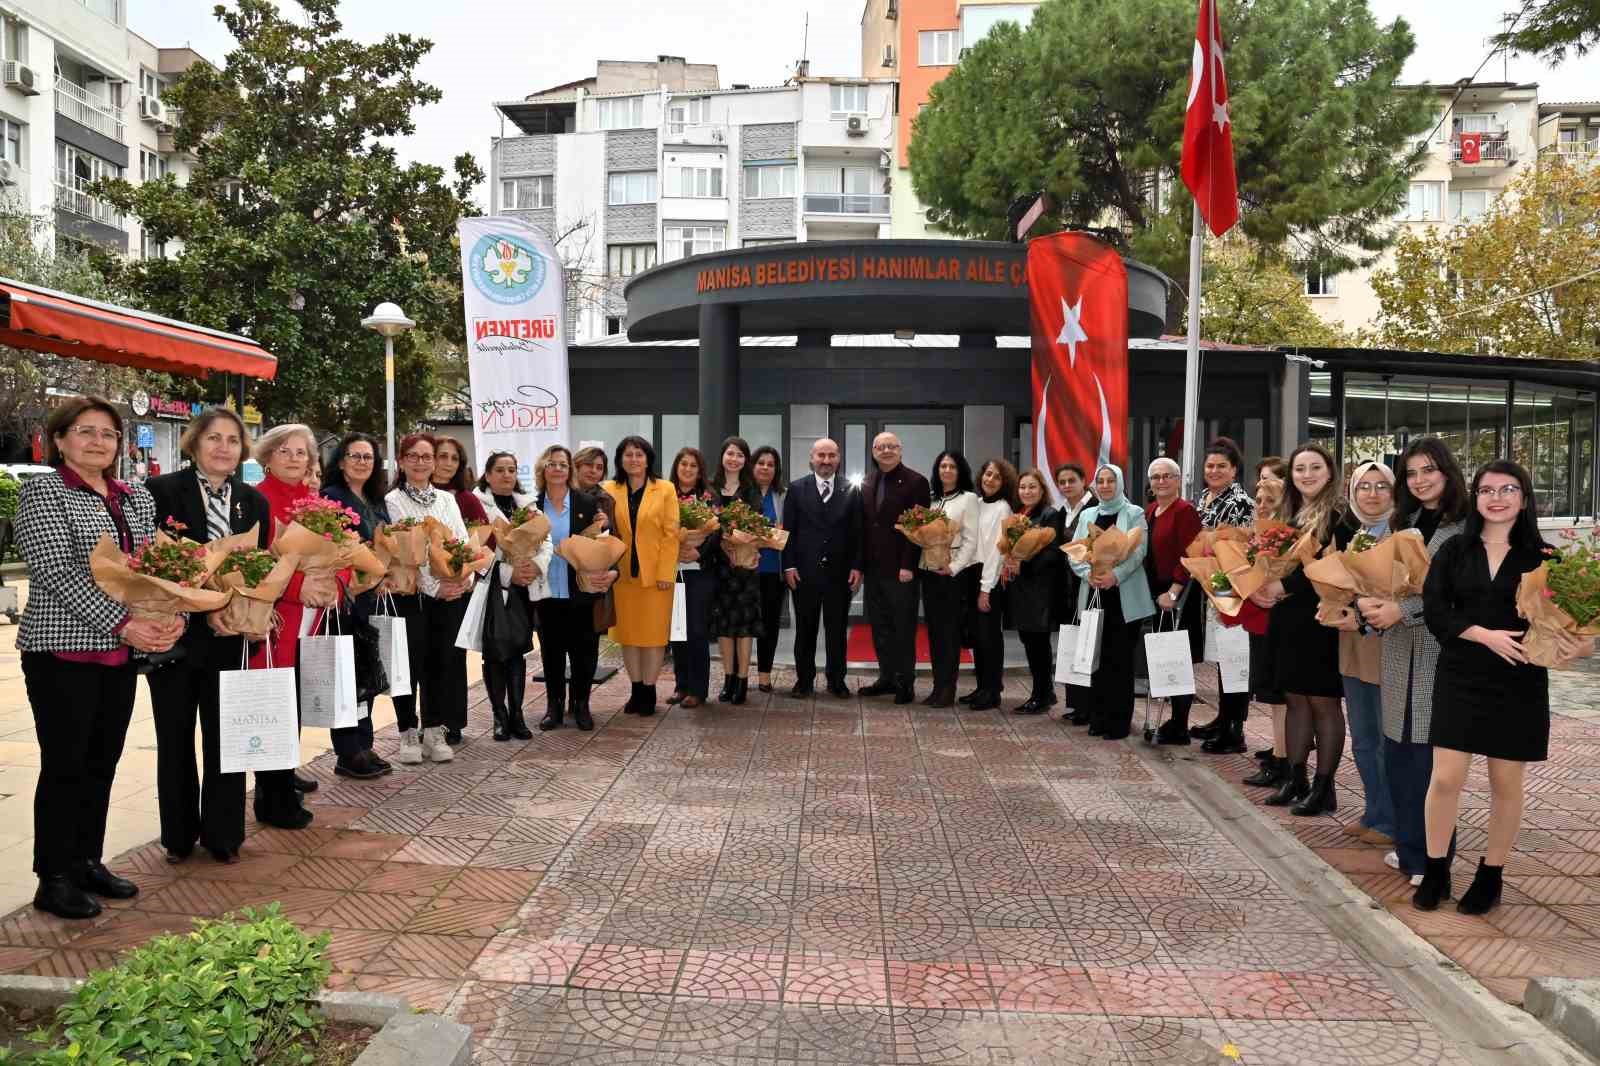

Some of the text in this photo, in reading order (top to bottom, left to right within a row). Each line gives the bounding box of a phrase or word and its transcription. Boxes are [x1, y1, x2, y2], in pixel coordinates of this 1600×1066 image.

[755, 256, 857, 287] BELEDİYESİ
[862, 256, 961, 280] HANIMLAR
[966, 255, 1005, 284] AİLE
